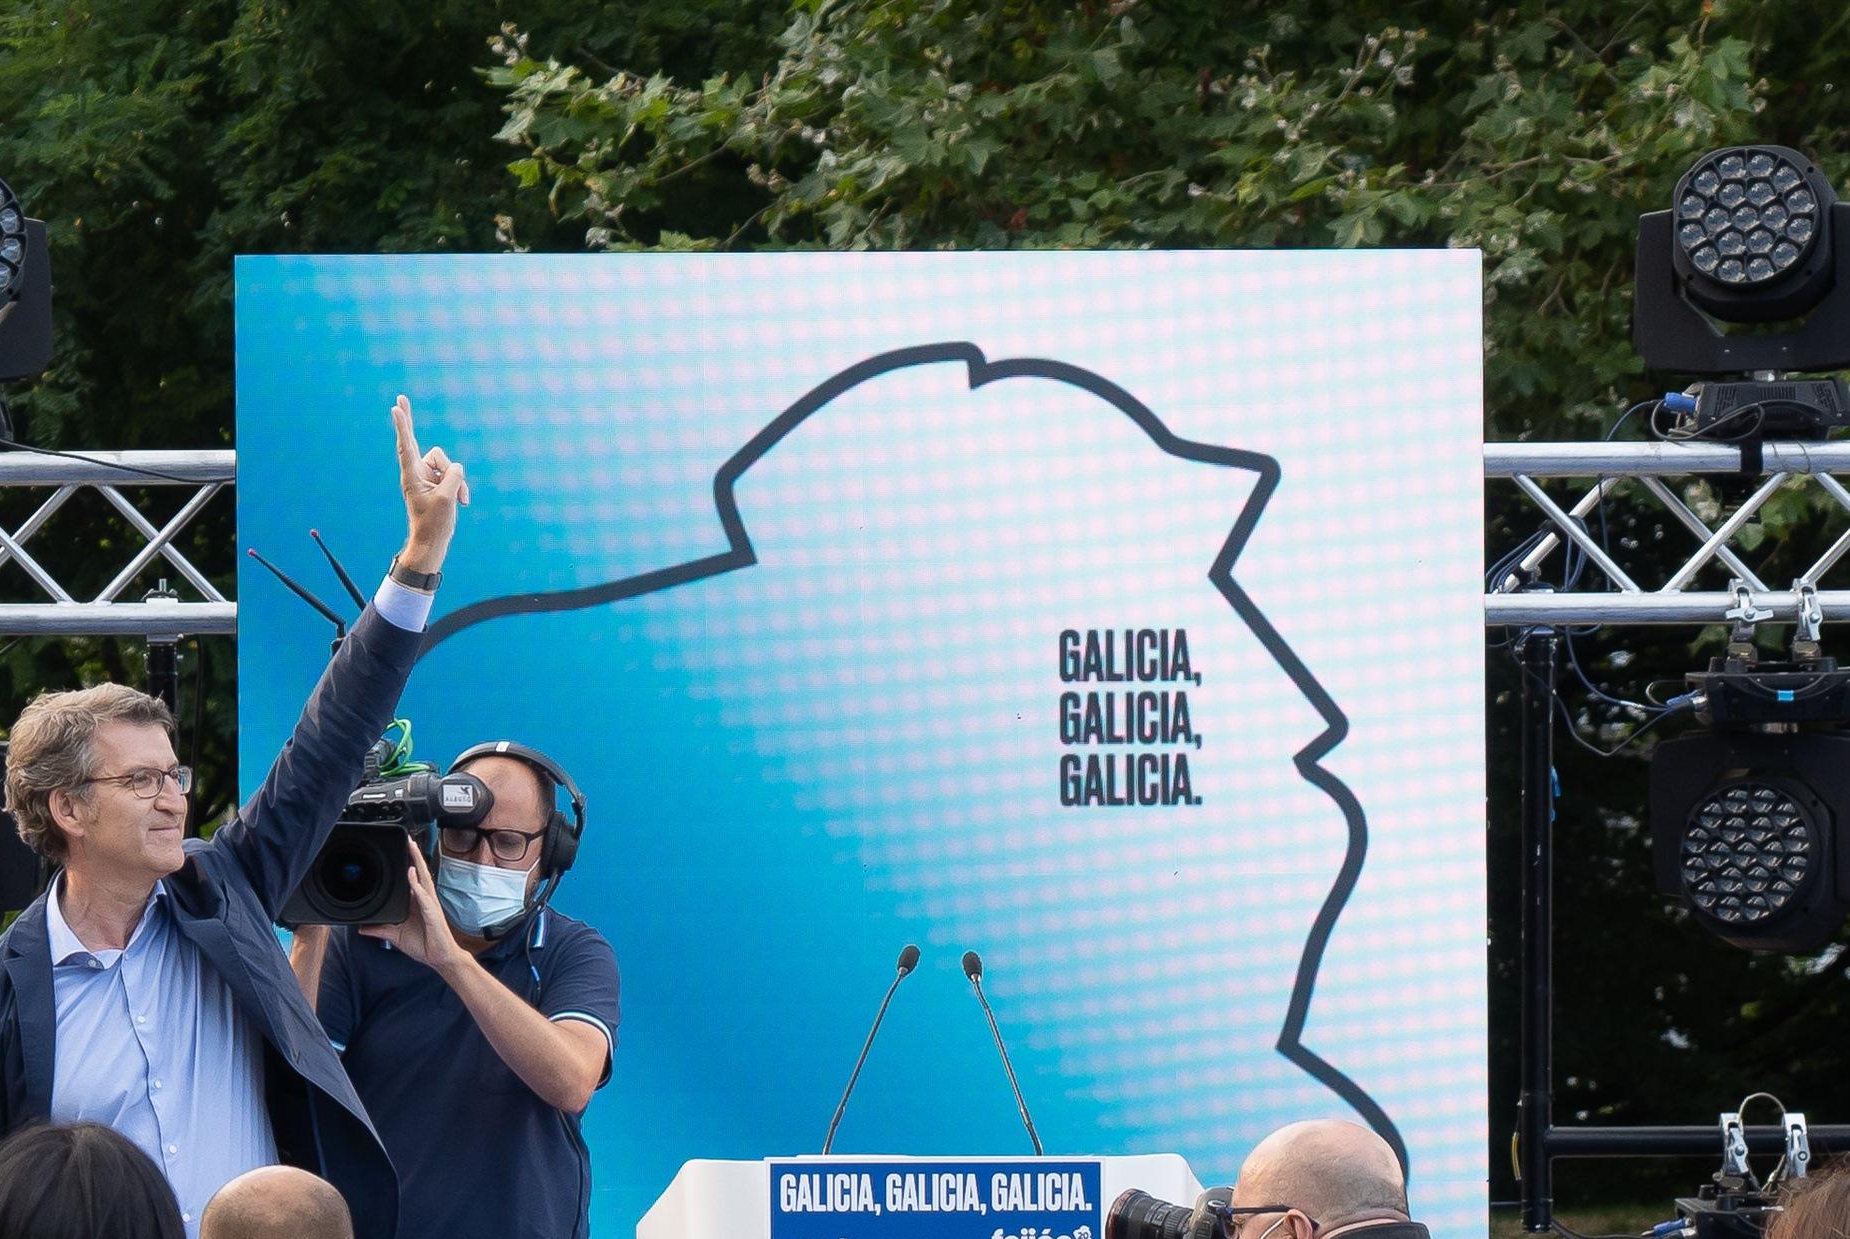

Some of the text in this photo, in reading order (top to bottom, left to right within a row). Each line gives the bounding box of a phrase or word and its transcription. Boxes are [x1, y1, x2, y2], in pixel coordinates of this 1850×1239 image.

[1059, 628, 1202, 686] GALICIA,
[1059, 691, 1202, 749] GALICIA,
[1060, 753, 1203, 806] GALICIA.
[780, 1172, 1093, 1216] GALICIA, GALICIA, GALICIA.
[1077, 1231, 1089, 1239] 20
